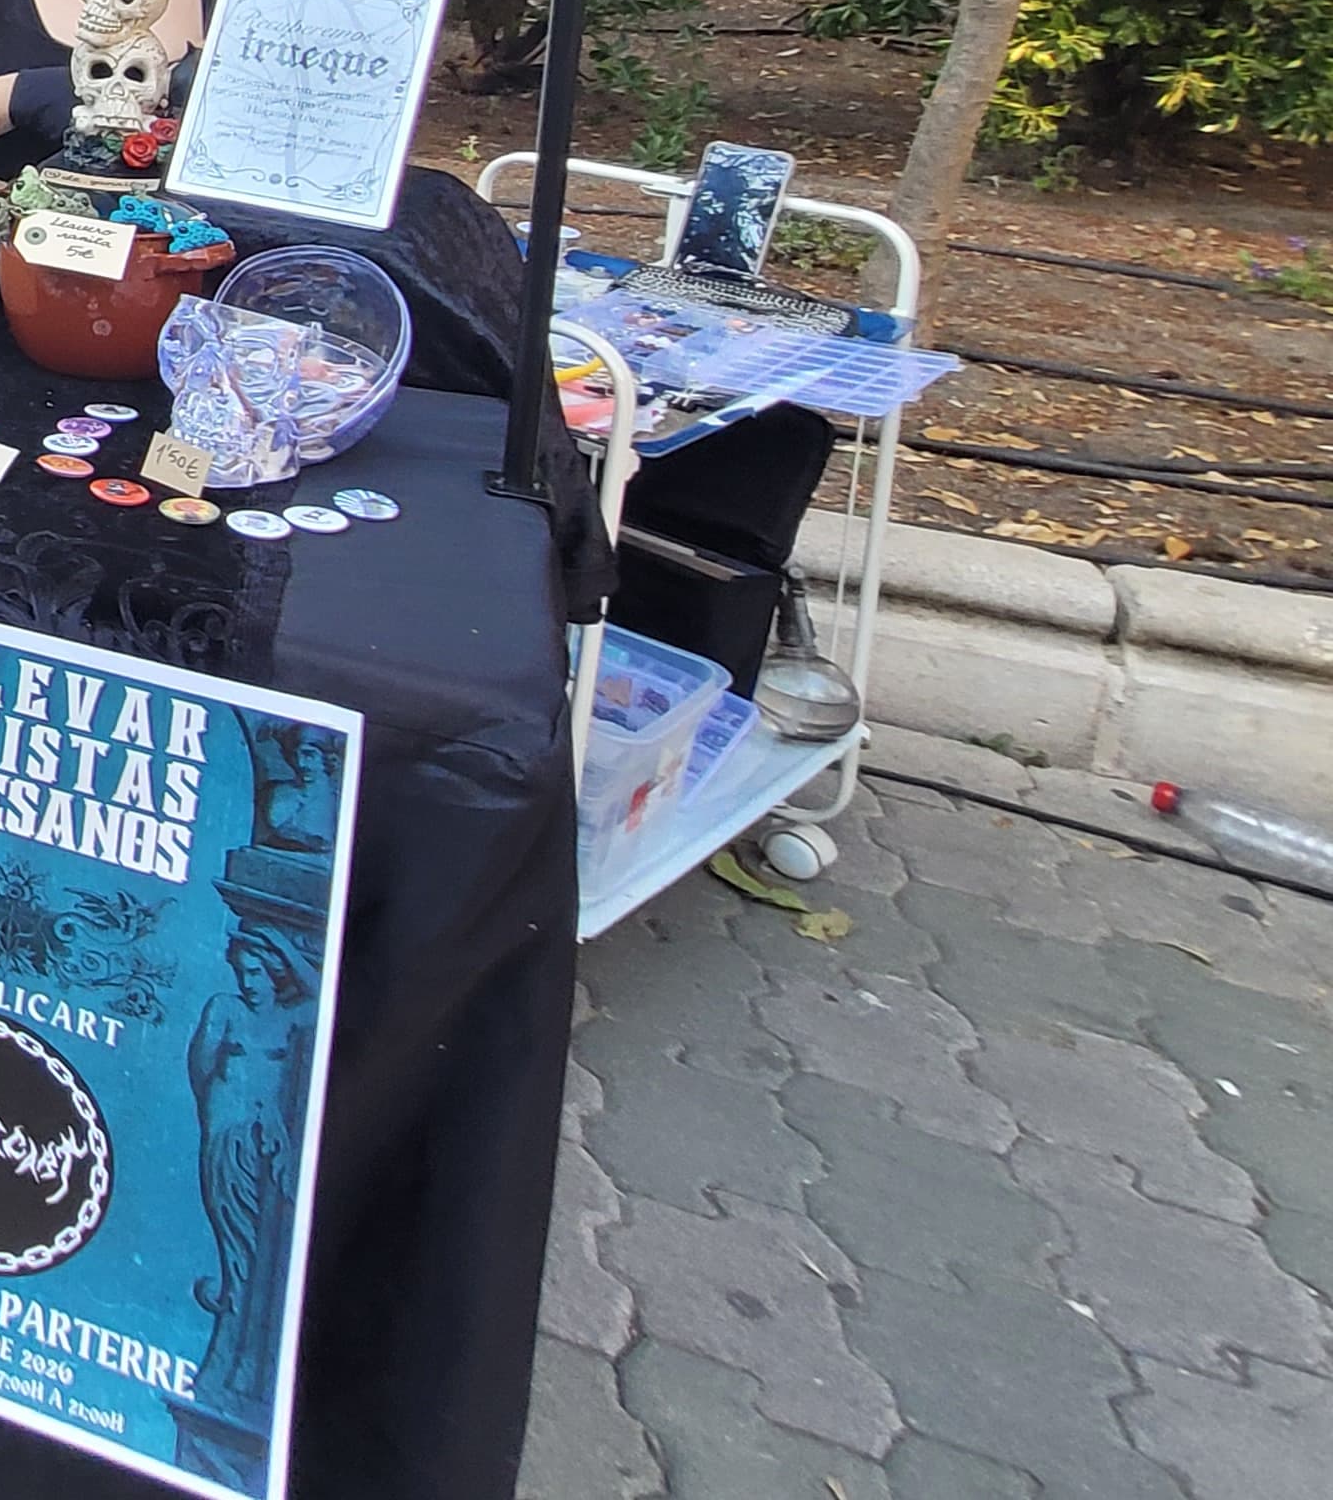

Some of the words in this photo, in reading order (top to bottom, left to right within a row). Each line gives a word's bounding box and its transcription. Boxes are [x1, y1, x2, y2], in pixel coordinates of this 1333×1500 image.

[239, 27, 389, 84] trueque
[50, 216, 117, 236] Llavero
[57, 232, 113, 248] ranita
[66, 245, 95, 259] 5€
[19, 1348, 75, 1386] 2026
[48, 1386, 64, 1409] A
